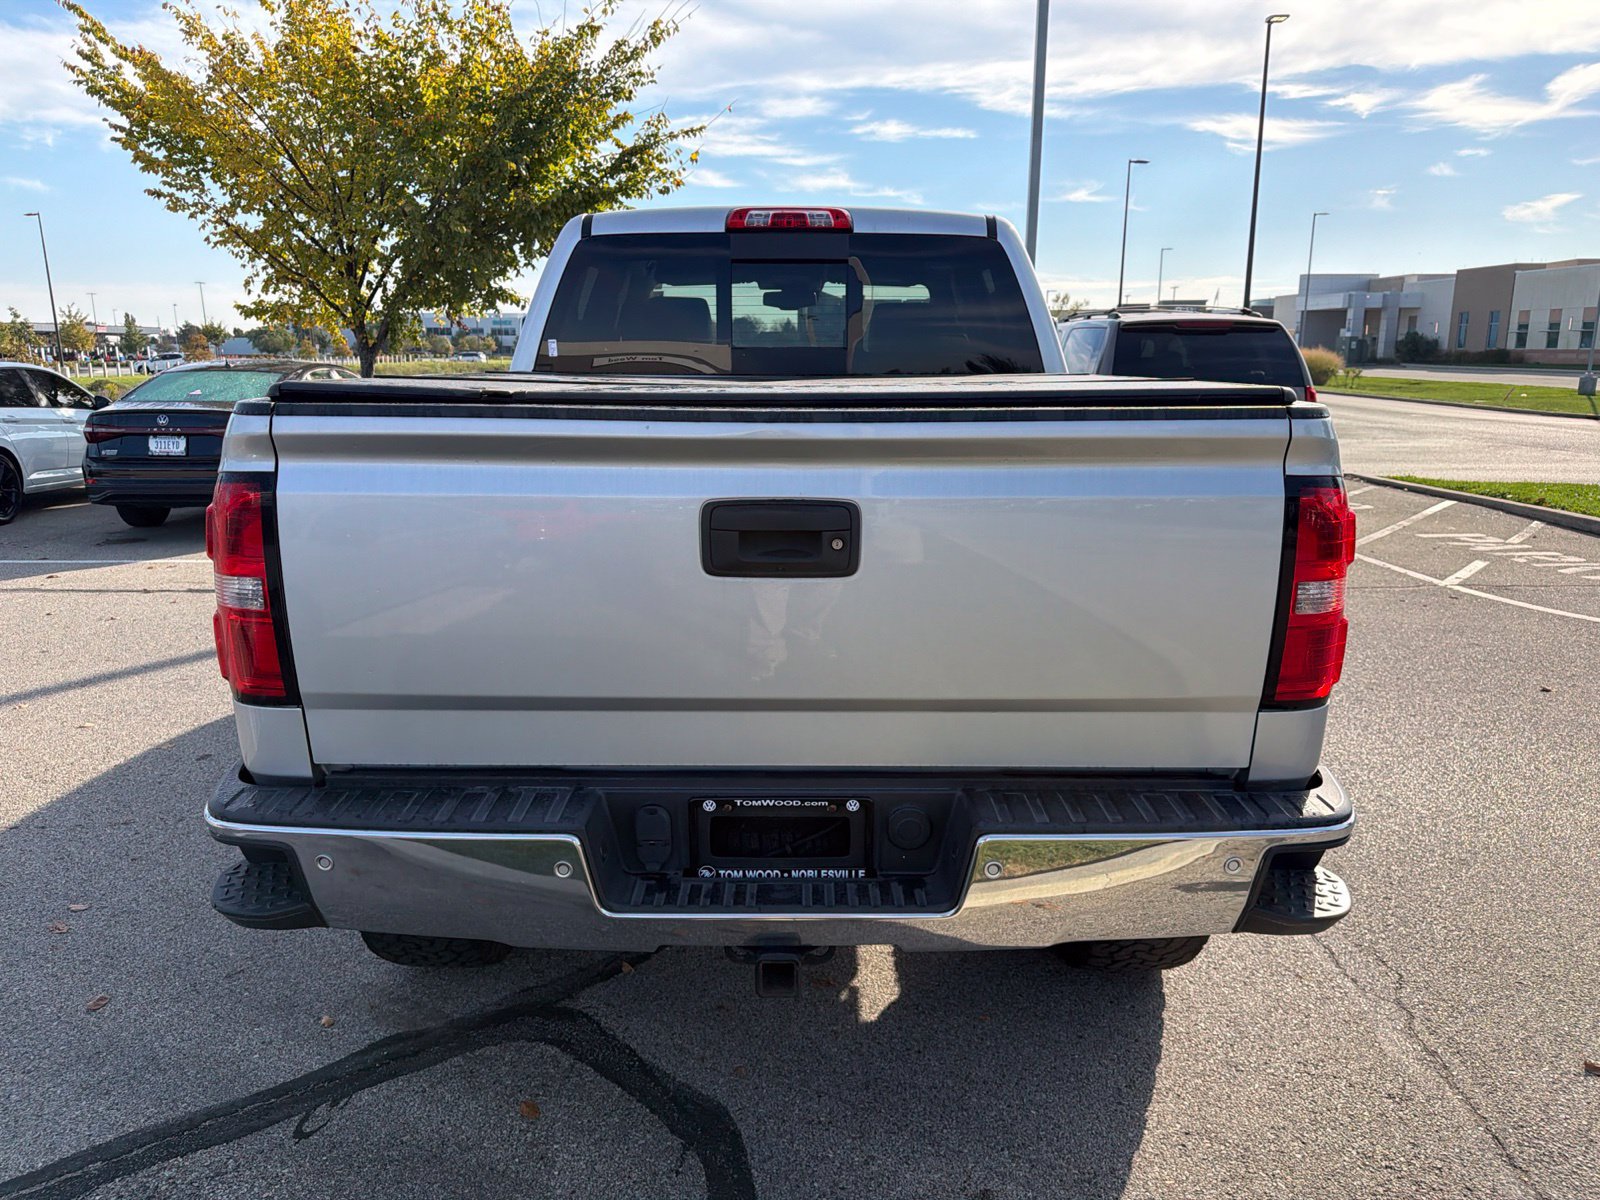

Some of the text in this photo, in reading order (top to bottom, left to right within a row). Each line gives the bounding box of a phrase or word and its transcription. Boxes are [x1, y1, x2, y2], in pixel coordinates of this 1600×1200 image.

[154, 440, 180, 450] 311EYD
[719, 869, 743, 878] TOM
[745, 869, 781, 878] WOOD
[791, 869, 865, 878] NOBLESVILLE
